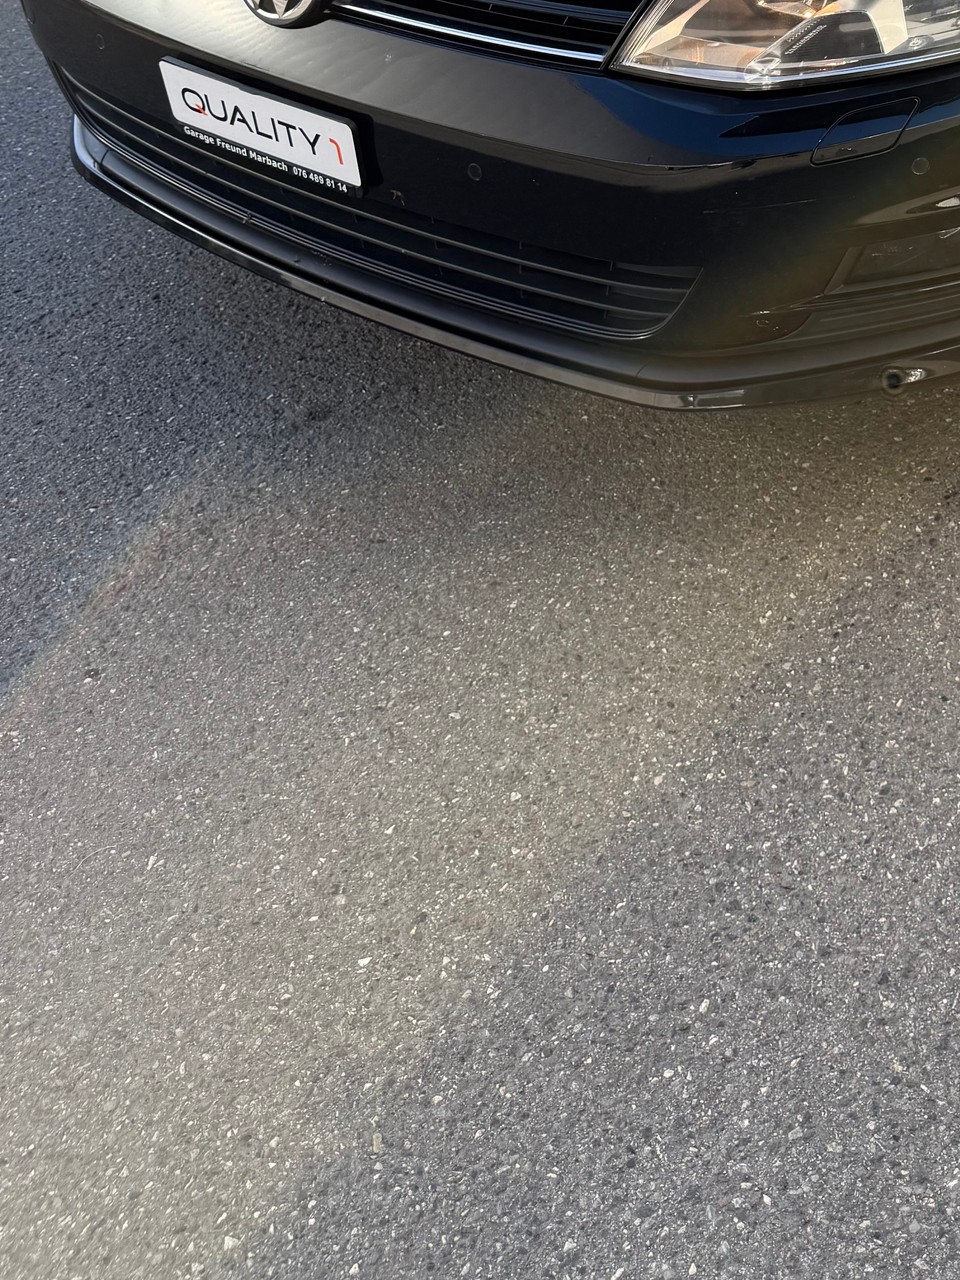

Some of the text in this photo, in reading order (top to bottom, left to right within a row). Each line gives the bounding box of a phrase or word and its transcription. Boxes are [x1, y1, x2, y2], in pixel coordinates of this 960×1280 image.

[181, 87, 321, 155] QUALITY
[183, 125, 348, 193] Garage Freund Marbach 076 489 81 14
